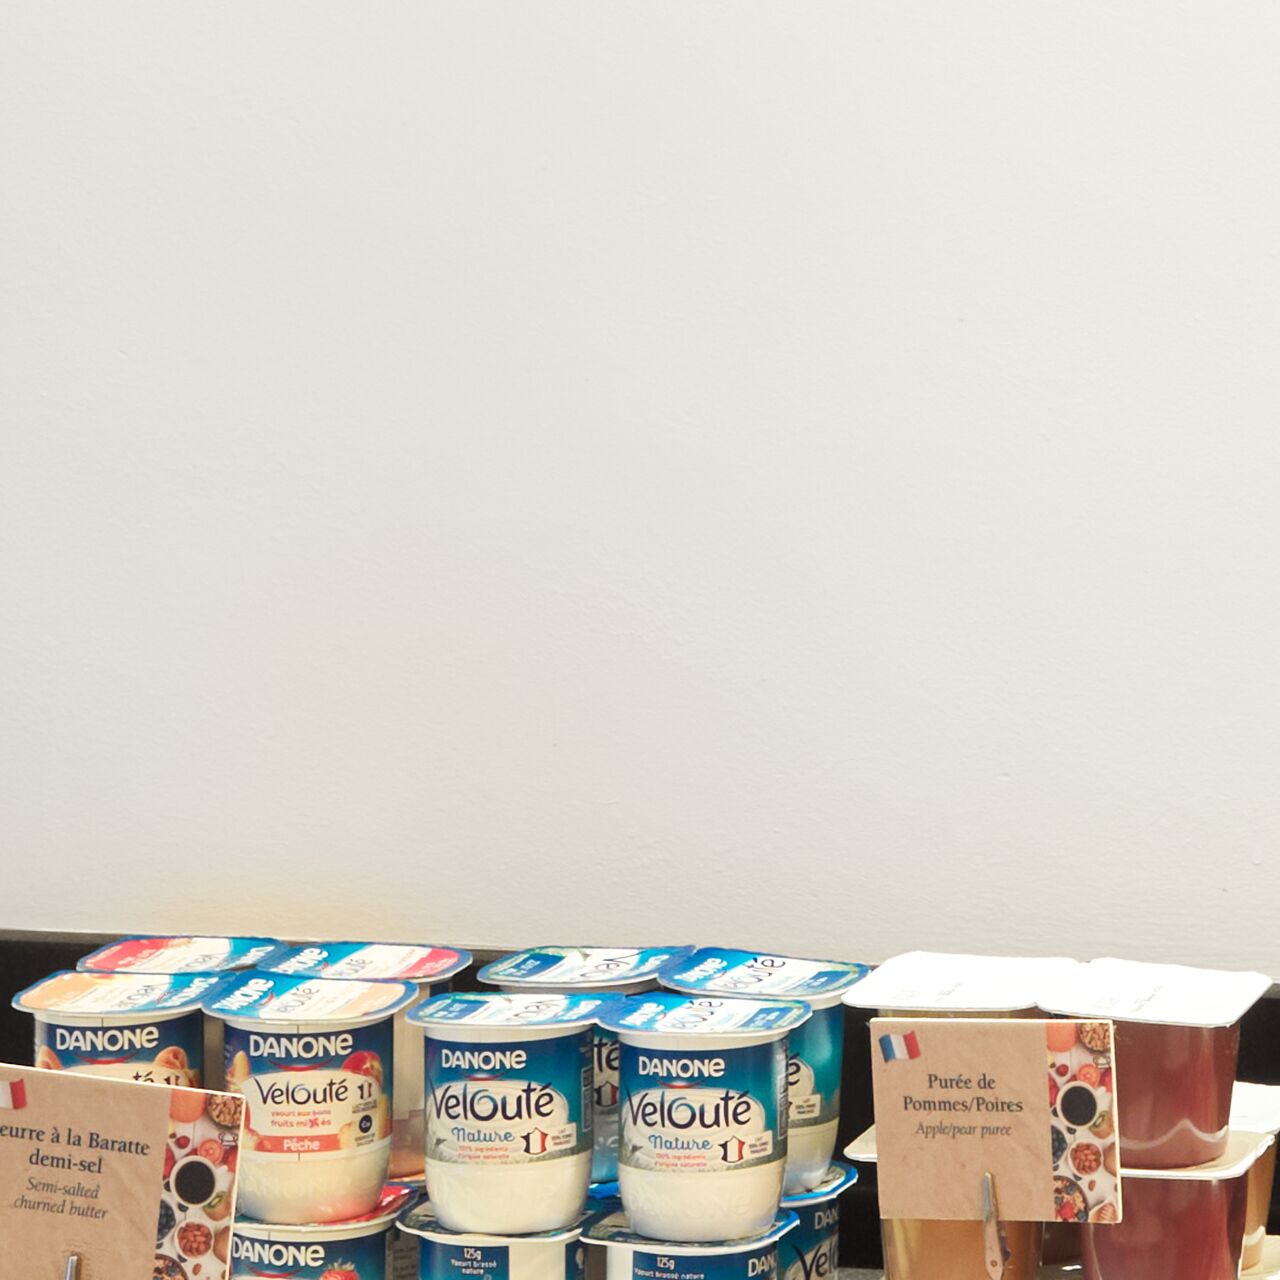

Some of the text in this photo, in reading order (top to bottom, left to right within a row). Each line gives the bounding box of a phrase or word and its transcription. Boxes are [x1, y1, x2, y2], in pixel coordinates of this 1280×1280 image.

[254, 1076, 348, 1105] Velouté
[927, 1073, 996, 1089] Purée de
[428, 1078, 554, 1121] Velouté
[624, 1084, 752, 1129] Velouté
[903, 1095, 1024, 1112] Pommes/Poires
[50, 1126, 61, 1144] à
[66, 1128, 82, 1146] la
[88, 1132, 151, 1156] Baratte
[916, 1121, 977, 1140] Apple/pear
[283, 1137, 320, 1151] Pêche
[29, 1148, 103, 1174] demi-sel
[26, 1176, 101, 1200] Semi-salted
[14, 1195, 109, 1219] churned butter
[463, 1247, 482, 1260] 125g
[656, 1256, 675, 1271] 125g
